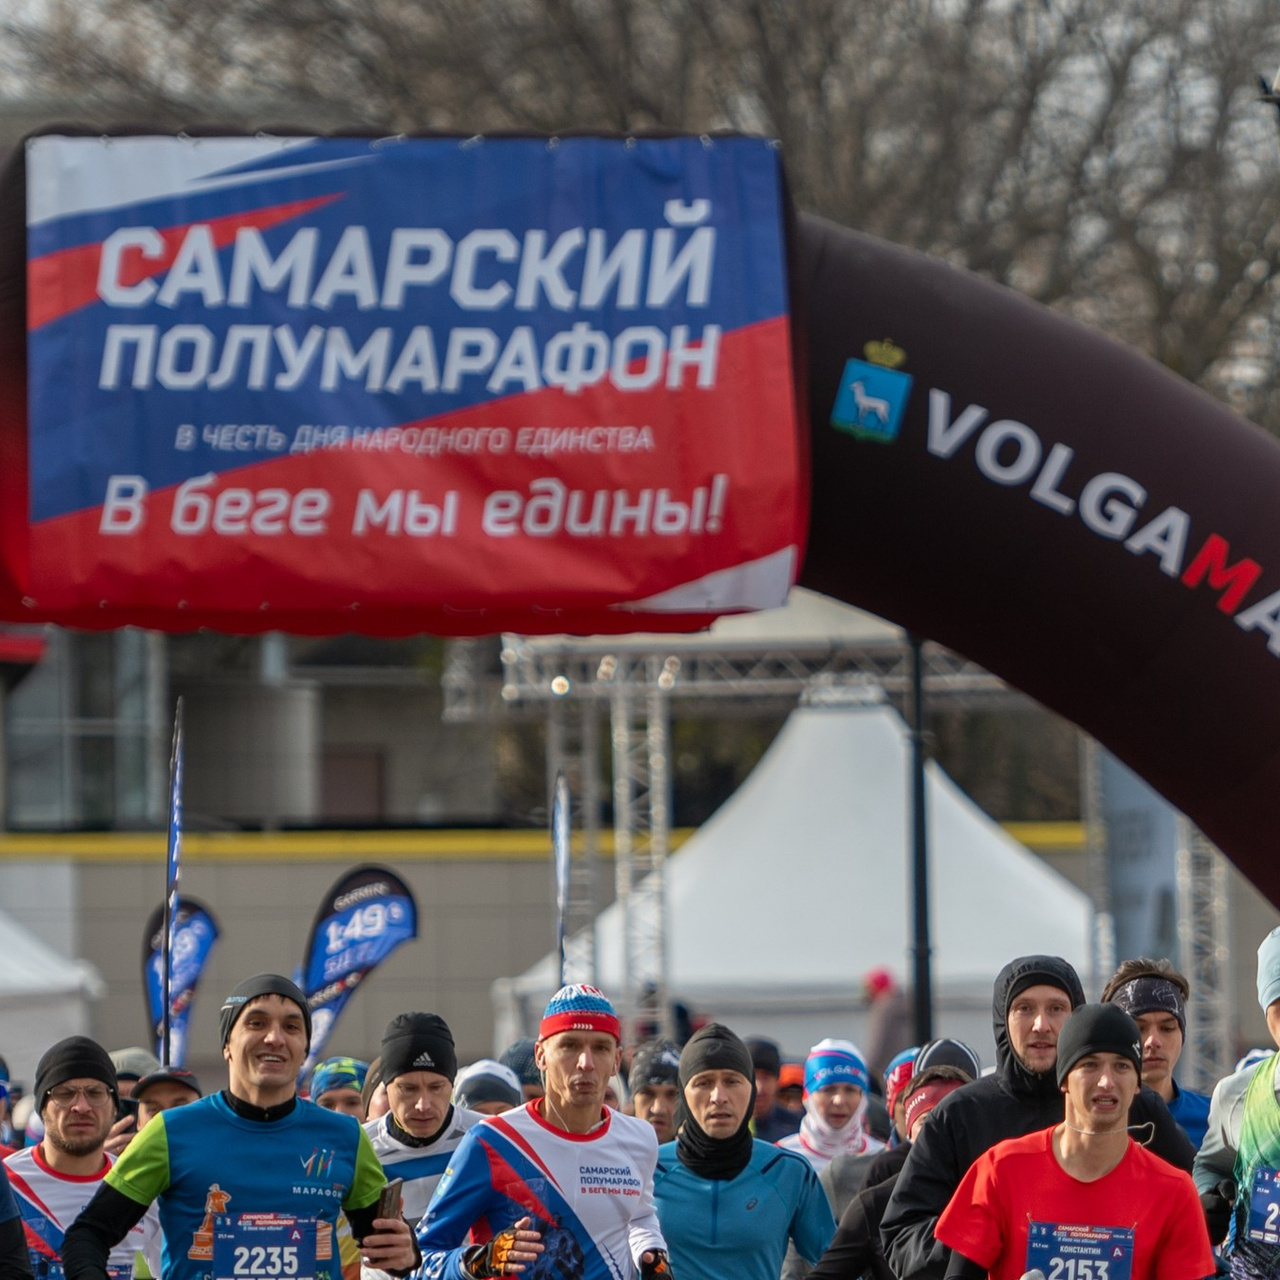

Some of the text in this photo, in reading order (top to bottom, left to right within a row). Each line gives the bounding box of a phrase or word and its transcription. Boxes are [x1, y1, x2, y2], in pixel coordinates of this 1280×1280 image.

[96, 198, 716, 311] САМАРСКИЙ
[98, 321, 721, 394] ПОЛУМАРАФОН
[174, 424, 655, 456] В ЧЕСТЬ ДНЯ НАРОДНОГО ЕДИНСТВА
[99, 471, 729, 538] В беге мы едины!
[579, 1166, 631, 1176] САМАРСКИЙ
[233, 1246, 298, 1275] 2235
[1059, 1245, 1101, 1255] КОНСТАНТИН
